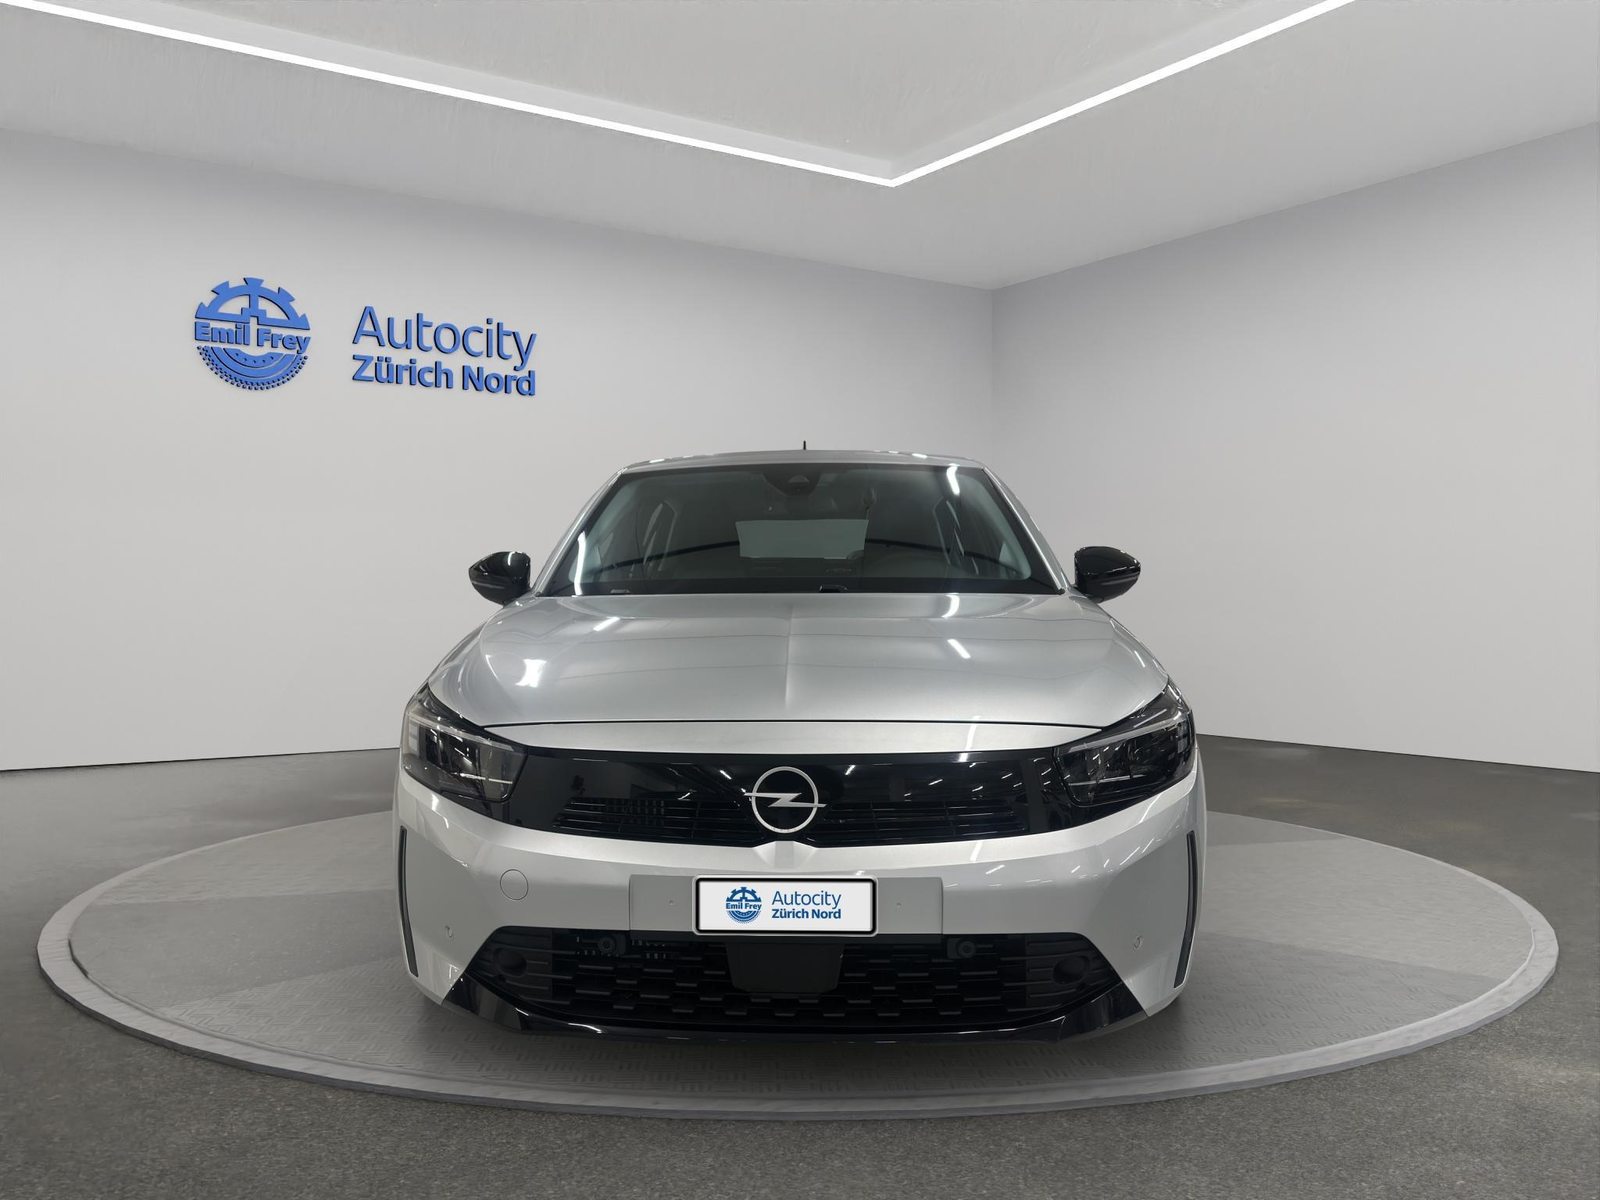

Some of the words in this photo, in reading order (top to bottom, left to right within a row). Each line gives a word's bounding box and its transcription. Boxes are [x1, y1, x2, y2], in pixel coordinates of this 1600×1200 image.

[194, 321, 250, 346] Emil
[257, 327, 311, 355] Frey
[352, 305, 537, 371] Autocity
[352, 353, 454, 389] Zürich
[462, 364, 536, 396] Nord
[726, 902, 743, 910] Emil
[745, 902, 762, 911] Frey
[772, 890, 842, 909] Autocity
[772, 908, 809, 919] Zürich
[811, 908, 841, 919] Nord
